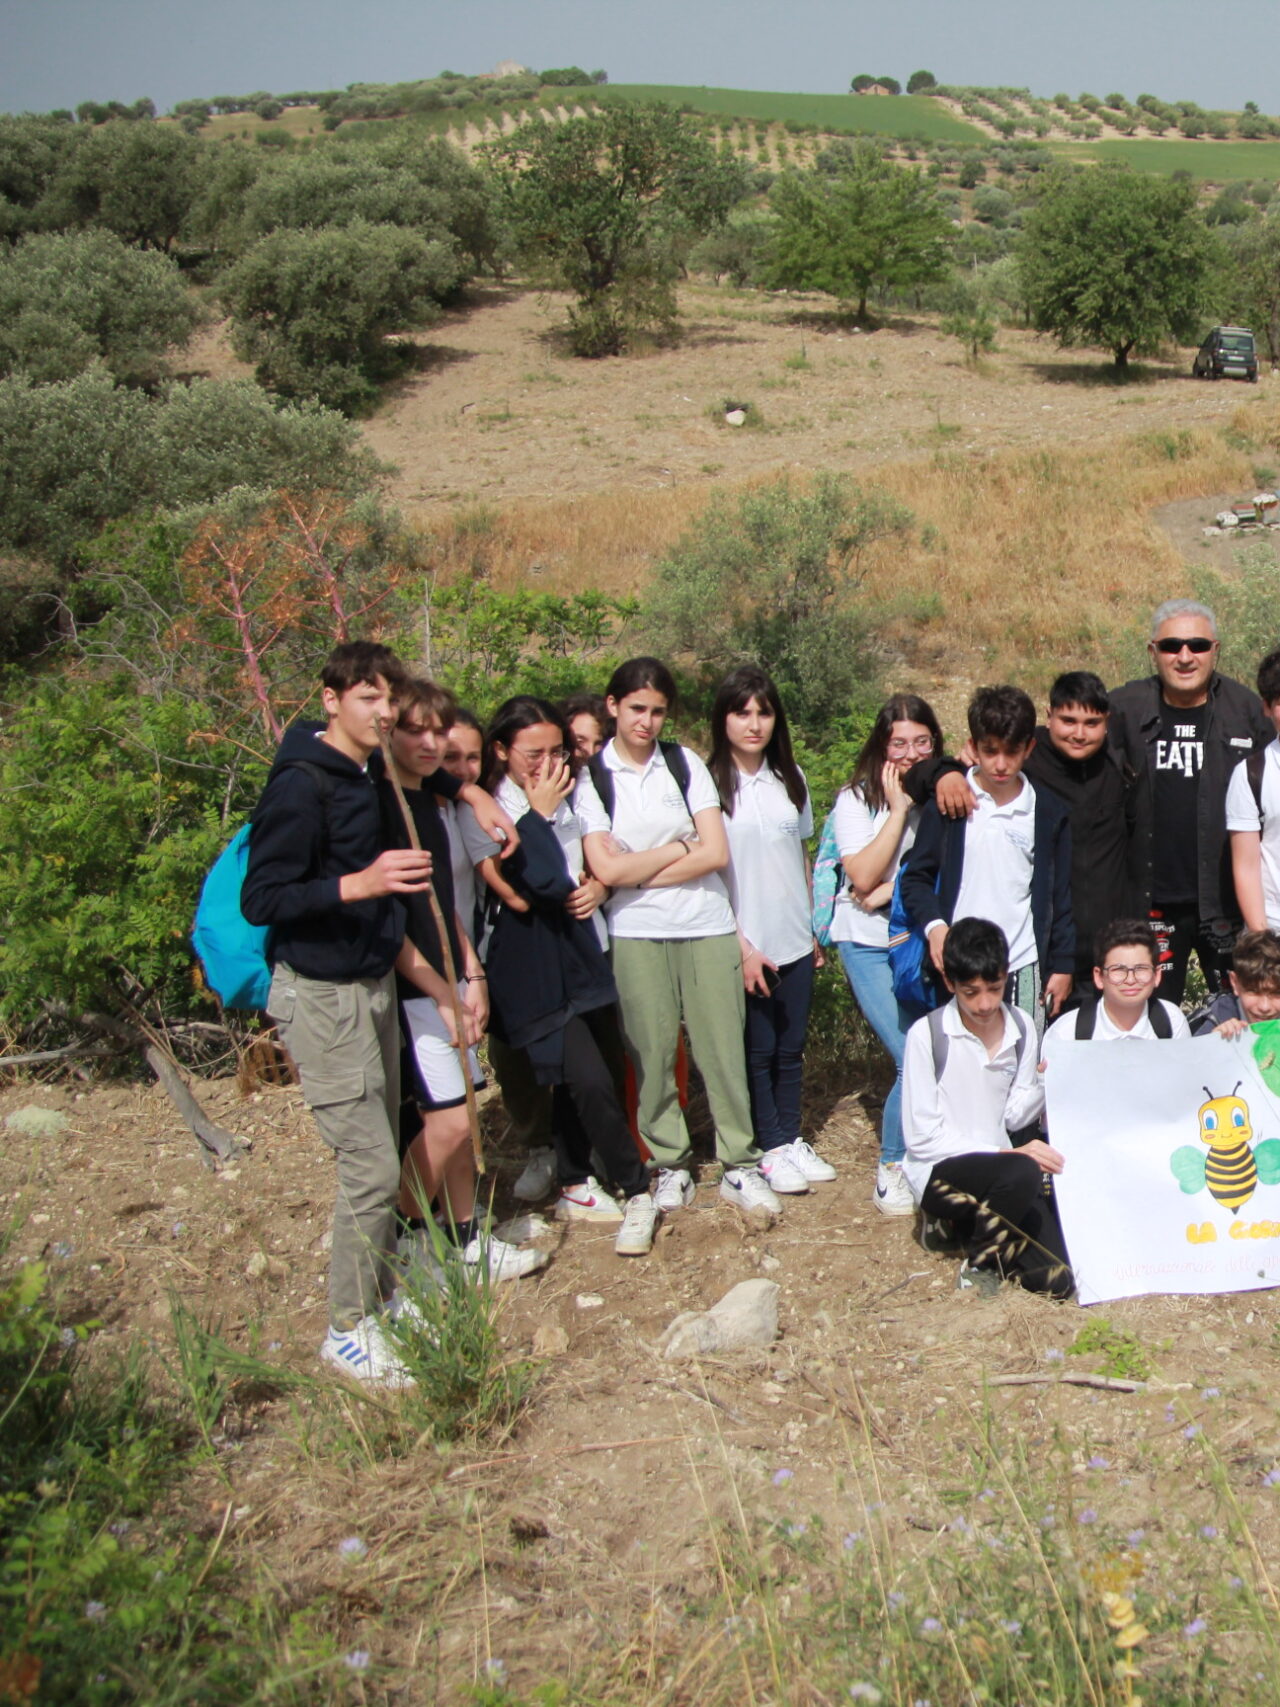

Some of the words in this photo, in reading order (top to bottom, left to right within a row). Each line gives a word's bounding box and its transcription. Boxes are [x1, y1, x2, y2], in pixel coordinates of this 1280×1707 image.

[1174, 725, 1196, 738] THE
[1156, 740, 1204, 778] EAT
[1187, 1222, 1217, 1244] LA
